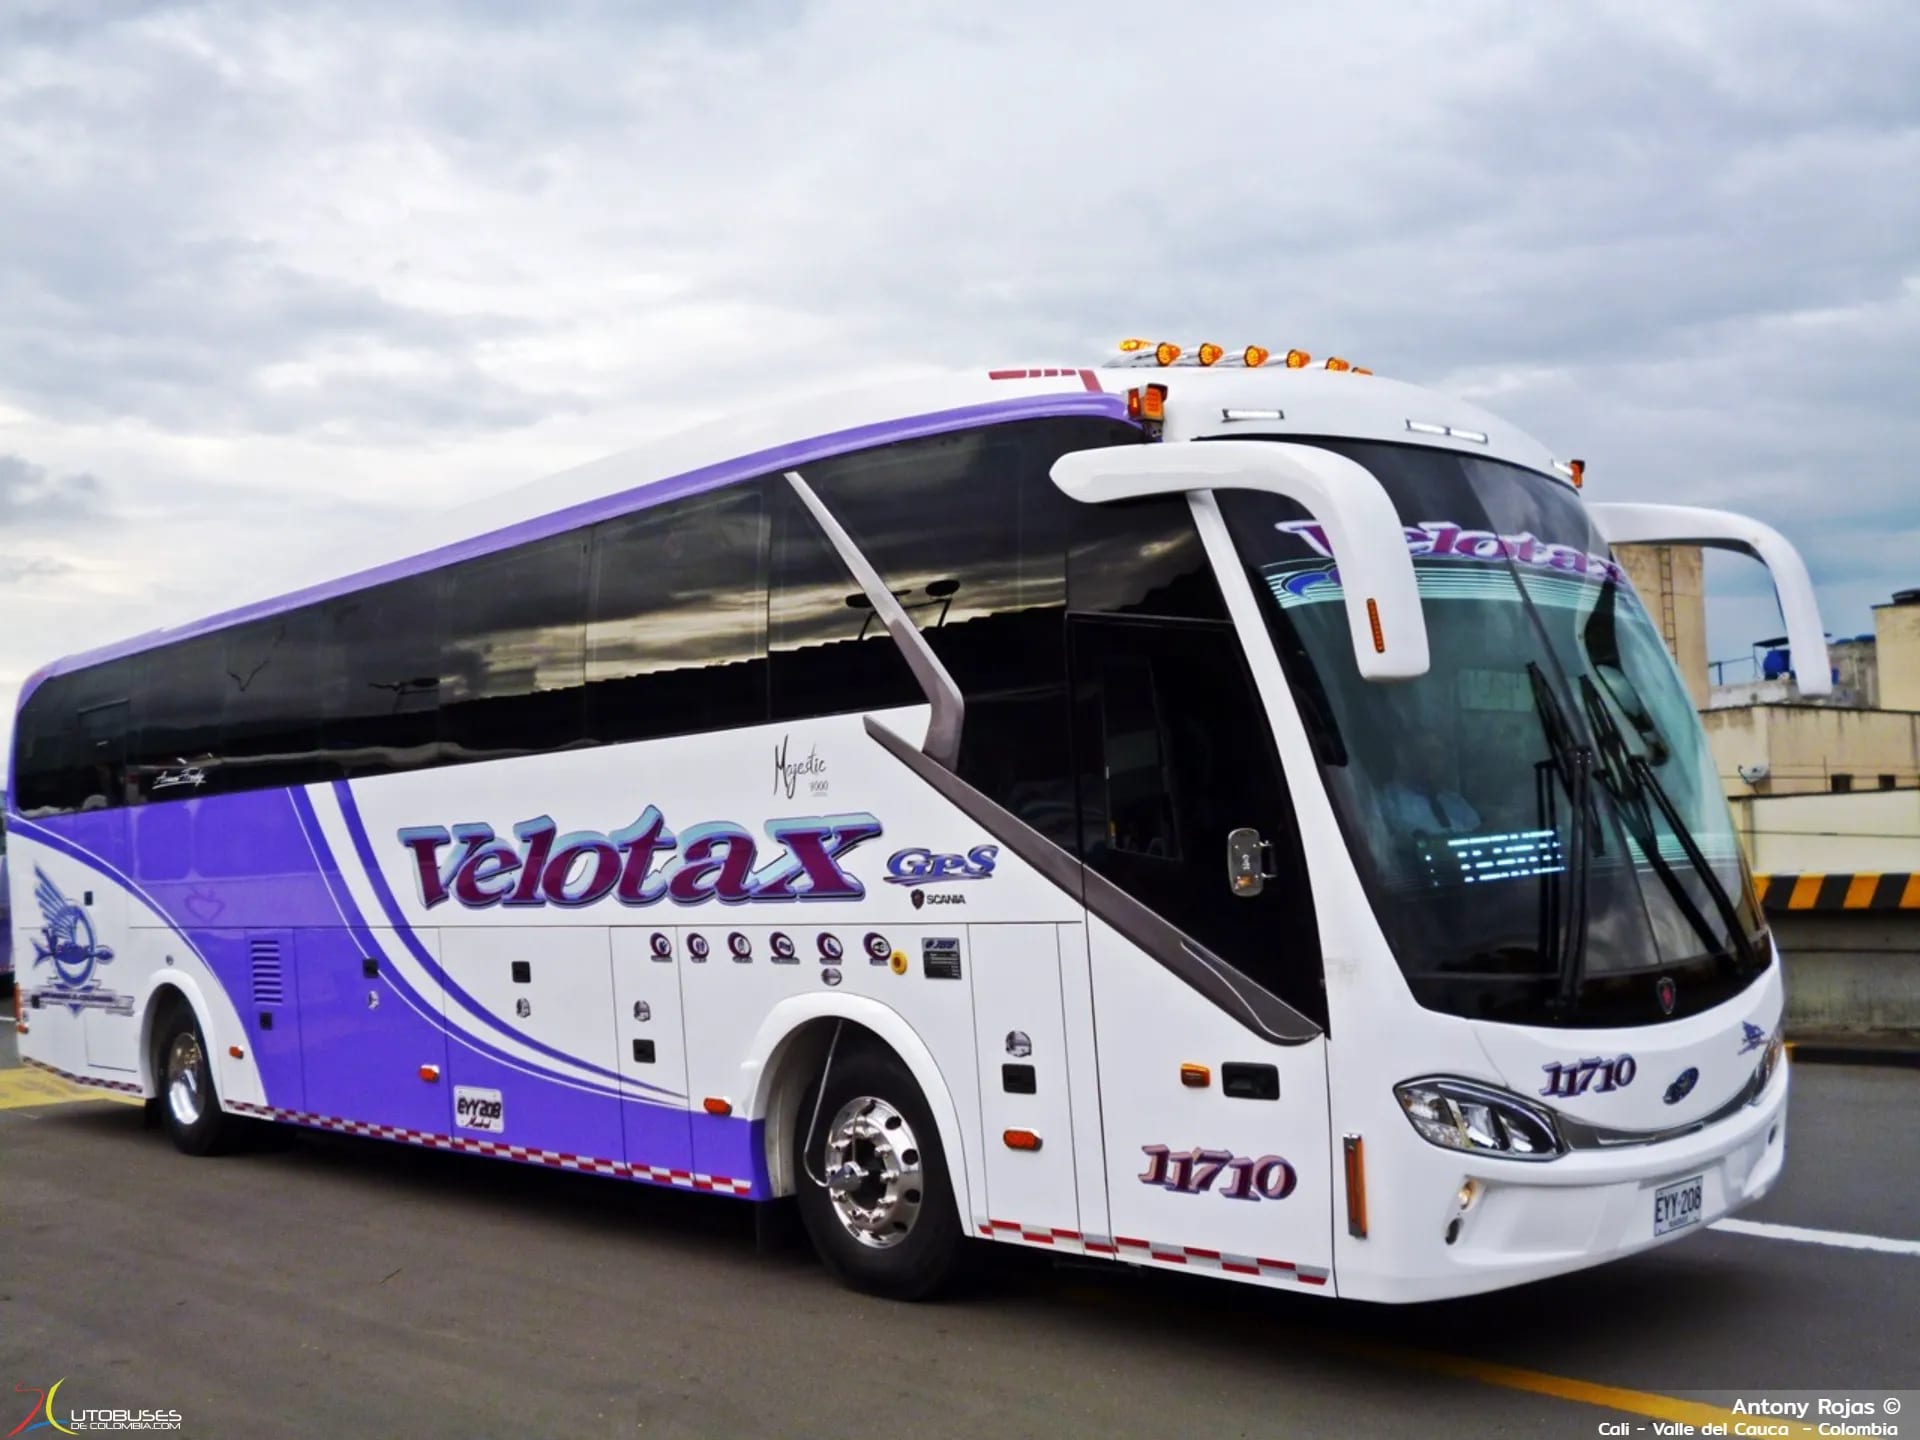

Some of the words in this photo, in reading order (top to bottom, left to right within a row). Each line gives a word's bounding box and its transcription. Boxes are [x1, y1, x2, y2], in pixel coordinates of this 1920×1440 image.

[926, 894, 966, 905] SCANIA
[1539, 1053, 1637, 1097] 11710
[1137, 1143, 1298, 1202] 11710
